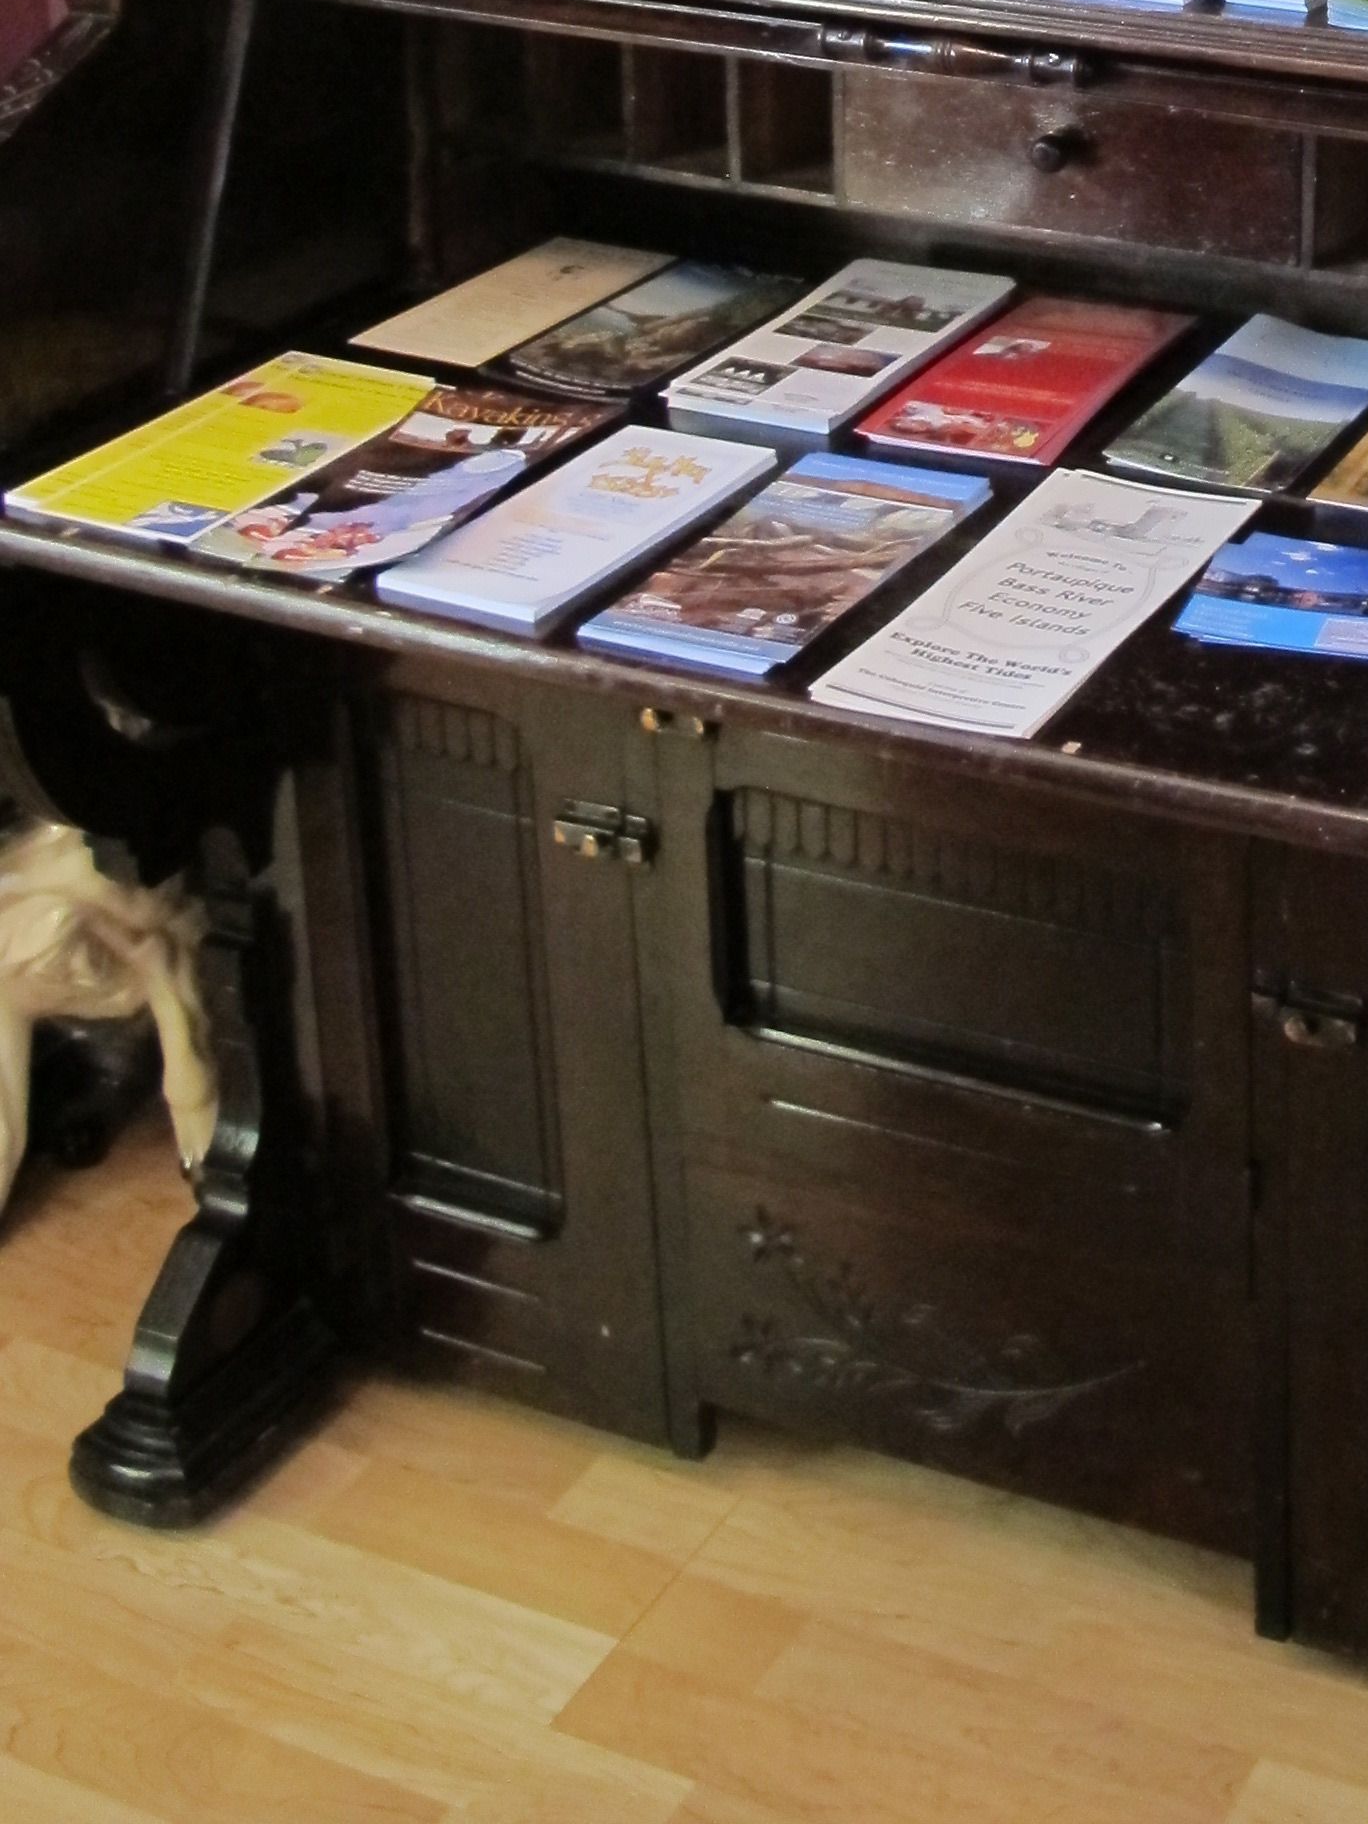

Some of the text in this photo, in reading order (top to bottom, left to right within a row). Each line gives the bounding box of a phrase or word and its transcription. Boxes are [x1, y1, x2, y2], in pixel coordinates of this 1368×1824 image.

[998, 577, 1114, 608] Bass River
[1005, 561, 1135, 595] Portaupique
[959, 600, 1092, 636] Five Islands
[987, 591, 1093, 620] Economy
[890, 631, 1073, 676] Explore The World's
[911, 648, 1033, 680] Highest Tides
